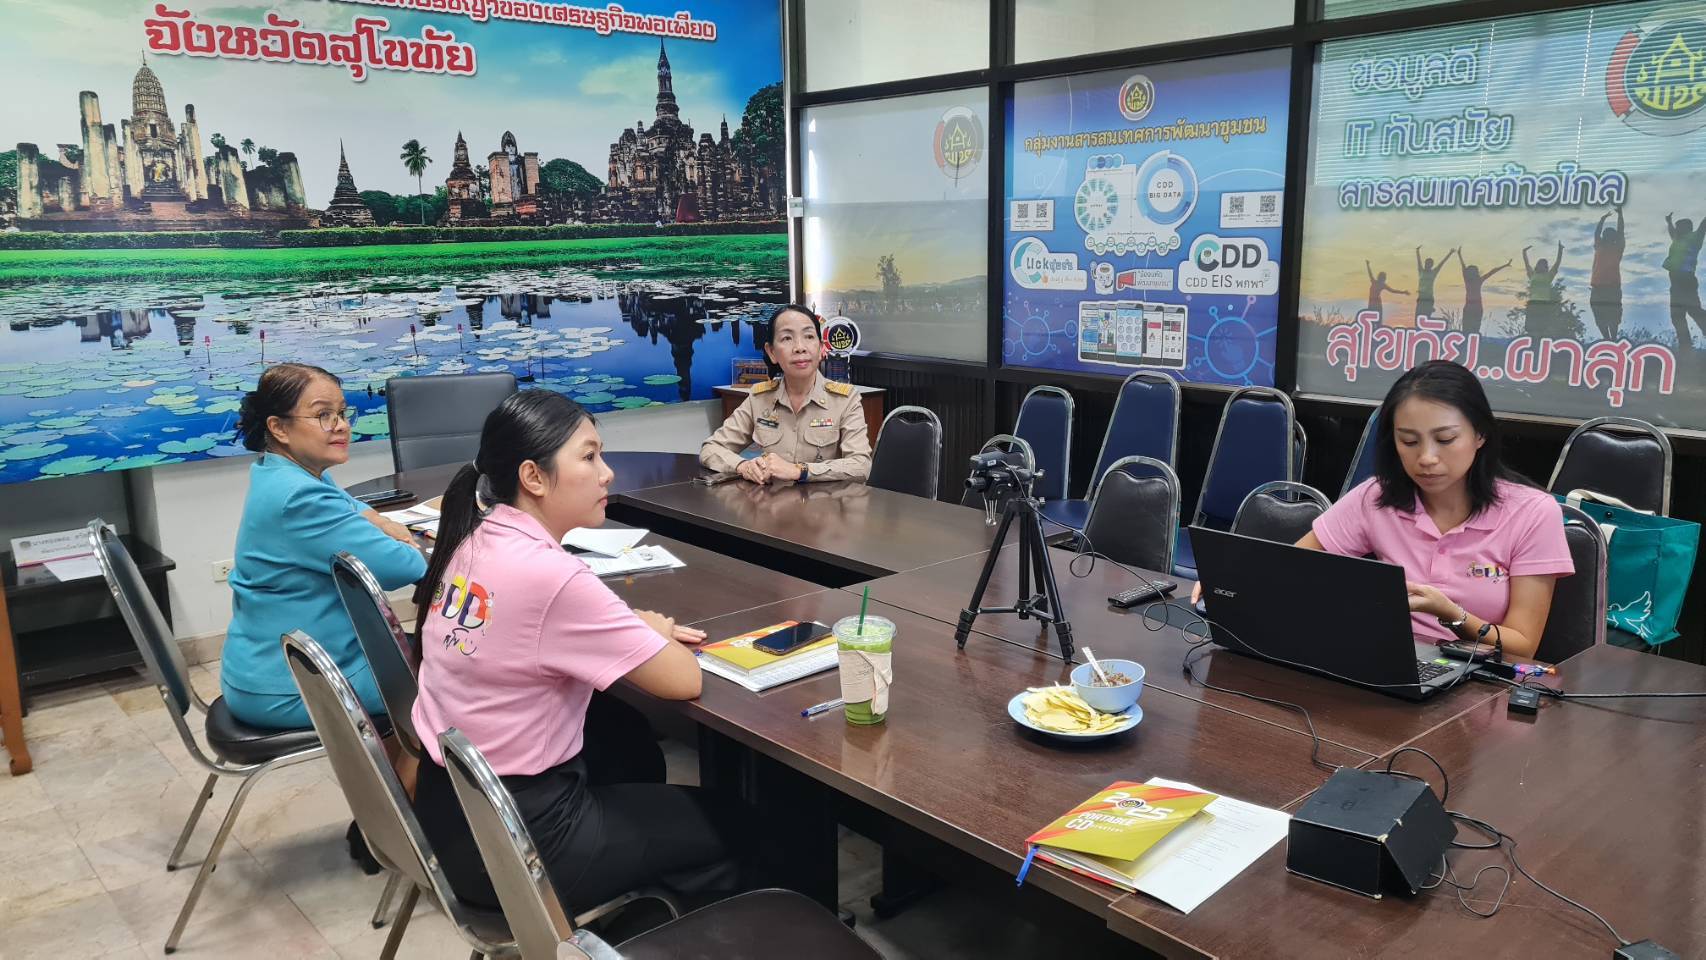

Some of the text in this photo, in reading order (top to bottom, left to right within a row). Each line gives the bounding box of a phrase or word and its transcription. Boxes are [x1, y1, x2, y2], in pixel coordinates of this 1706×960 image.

[143, 3, 475, 79] จังหวัดสุโขทัย
[1024, 116, 1268, 157] กลุ่มงานสารสนเทศการพัฒนาชุมชน
[1344, 111, 1512, 156] IT ทันสมัย
[1339, 161, 1627, 208] สารสนเทศก้าวไกล
[1194, 239, 1262, 272] CDD
[1185, 277, 1208, 288] CDD
[1211, 274, 1233, 288] EIS
[1213, 587, 1237, 598] acer
[1067, 818, 1094, 831] CD
